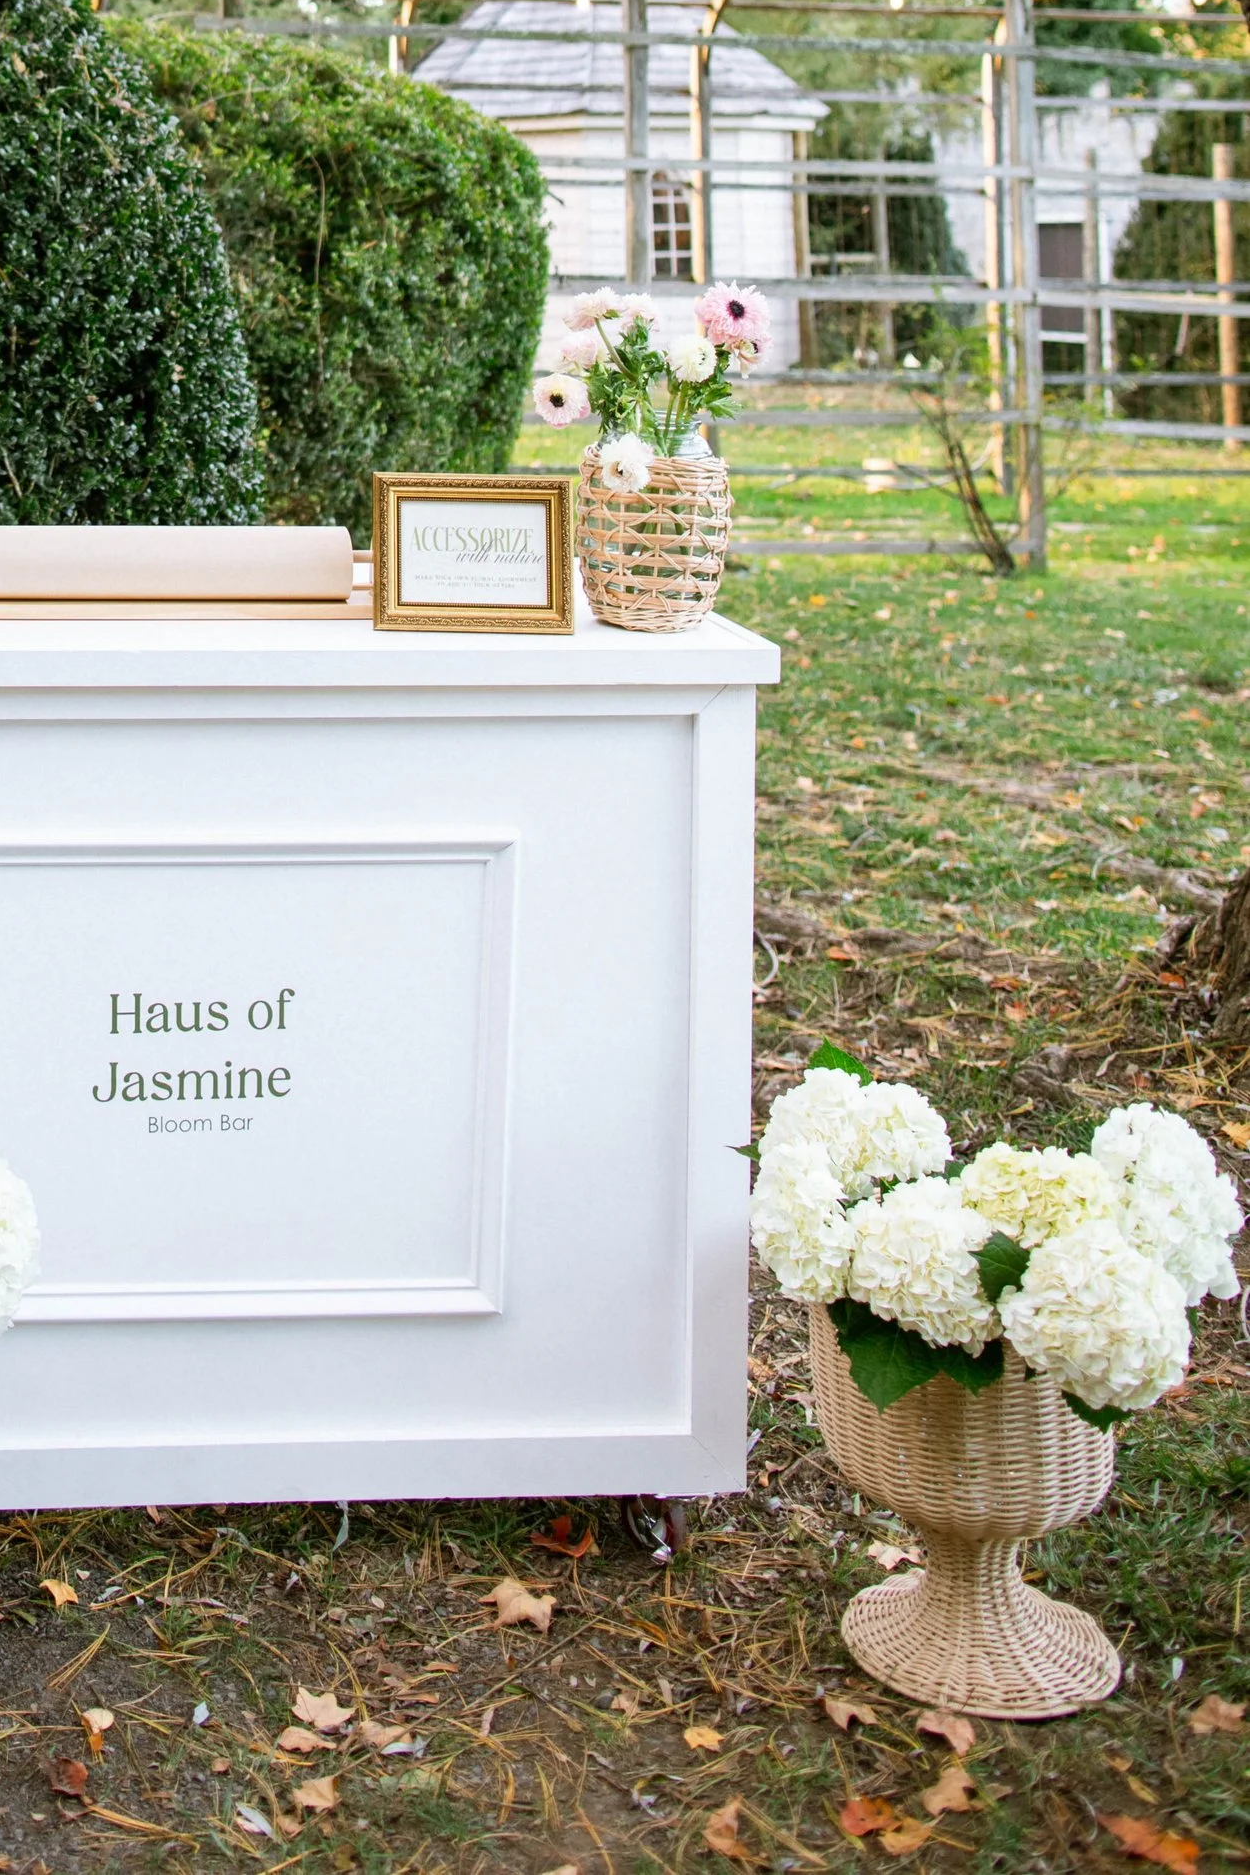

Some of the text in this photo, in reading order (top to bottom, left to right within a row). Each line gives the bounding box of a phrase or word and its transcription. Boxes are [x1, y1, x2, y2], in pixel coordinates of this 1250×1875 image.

[410, 525, 534, 554] ACCESSORIZE
[455, 541, 544, 564] with nature
[109, 988, 296, 1034] Haus of
[92, 1060, 292, 1103] Jasmine
[148, 1114, 254, 1133] Bloom Bar
